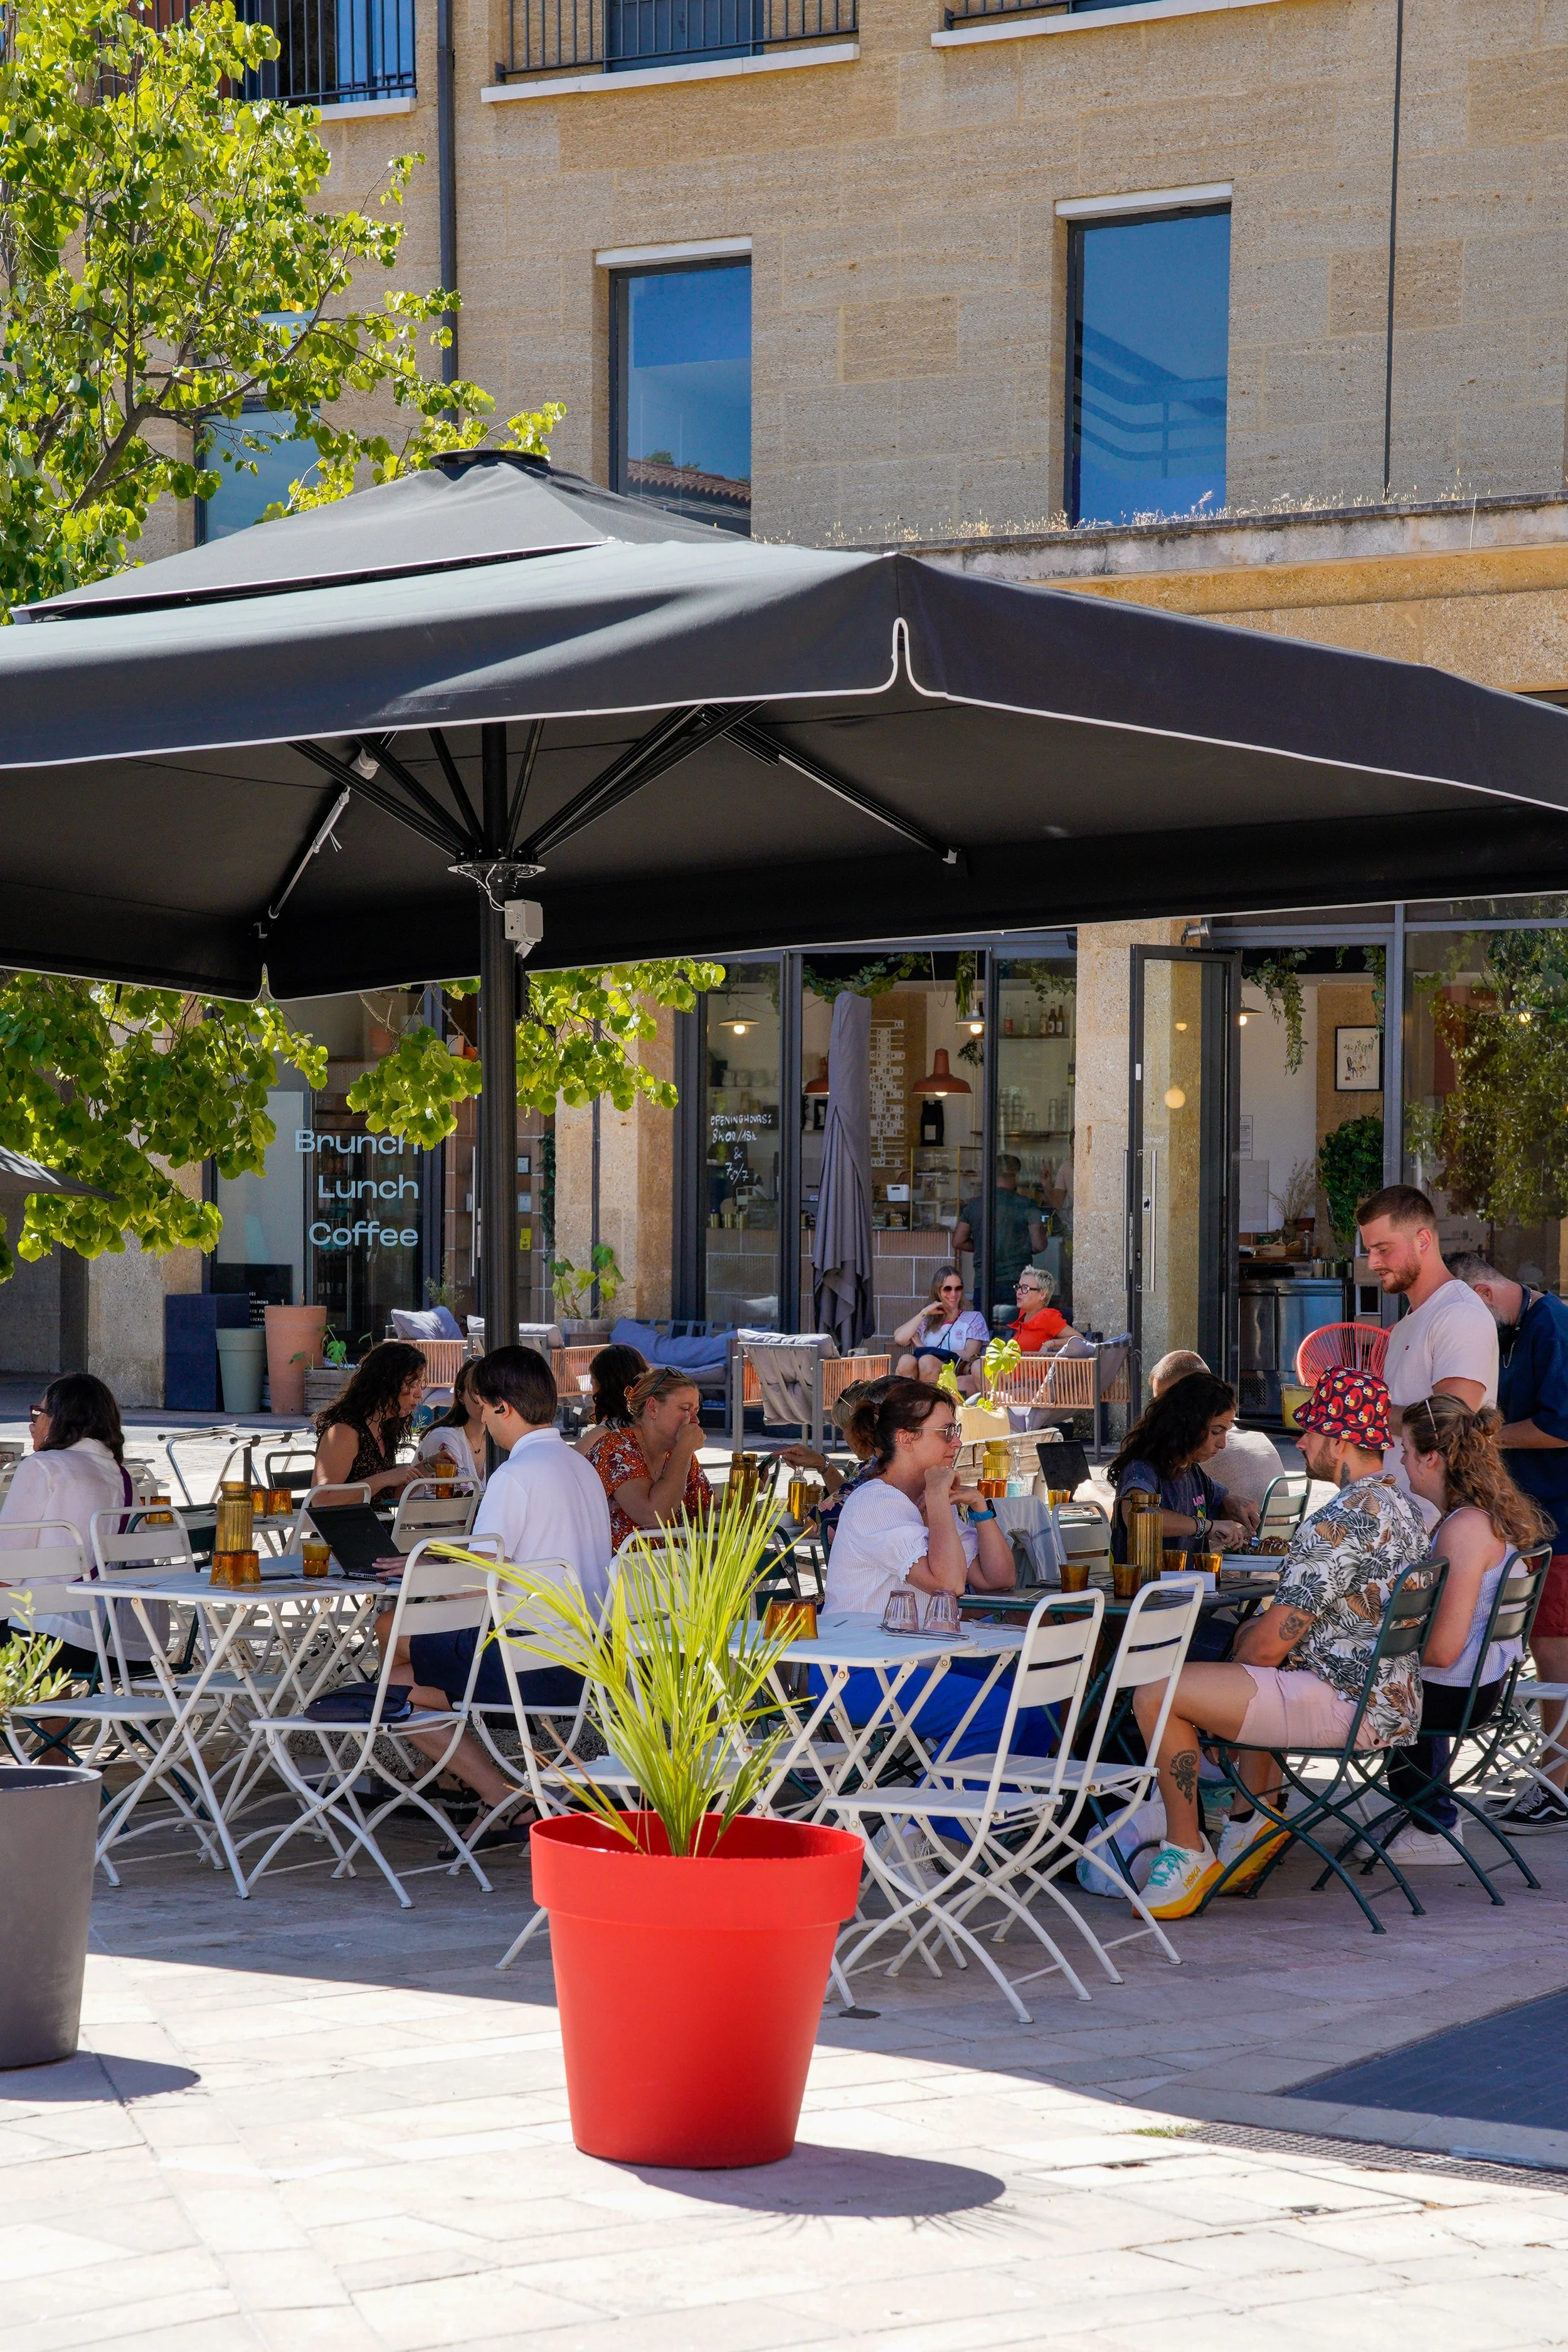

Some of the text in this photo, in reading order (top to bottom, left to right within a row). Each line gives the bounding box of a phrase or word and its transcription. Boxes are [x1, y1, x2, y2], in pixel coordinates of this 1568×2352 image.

[295, 1130, 418, 1155] Brunch
[733, 1146, 743, 1160] &
[318, 1174, 418, 1199] Lunch
[309, 1221, 418, 1246] Coffee
[1183, 1865, 1201, 1890] HOKA
